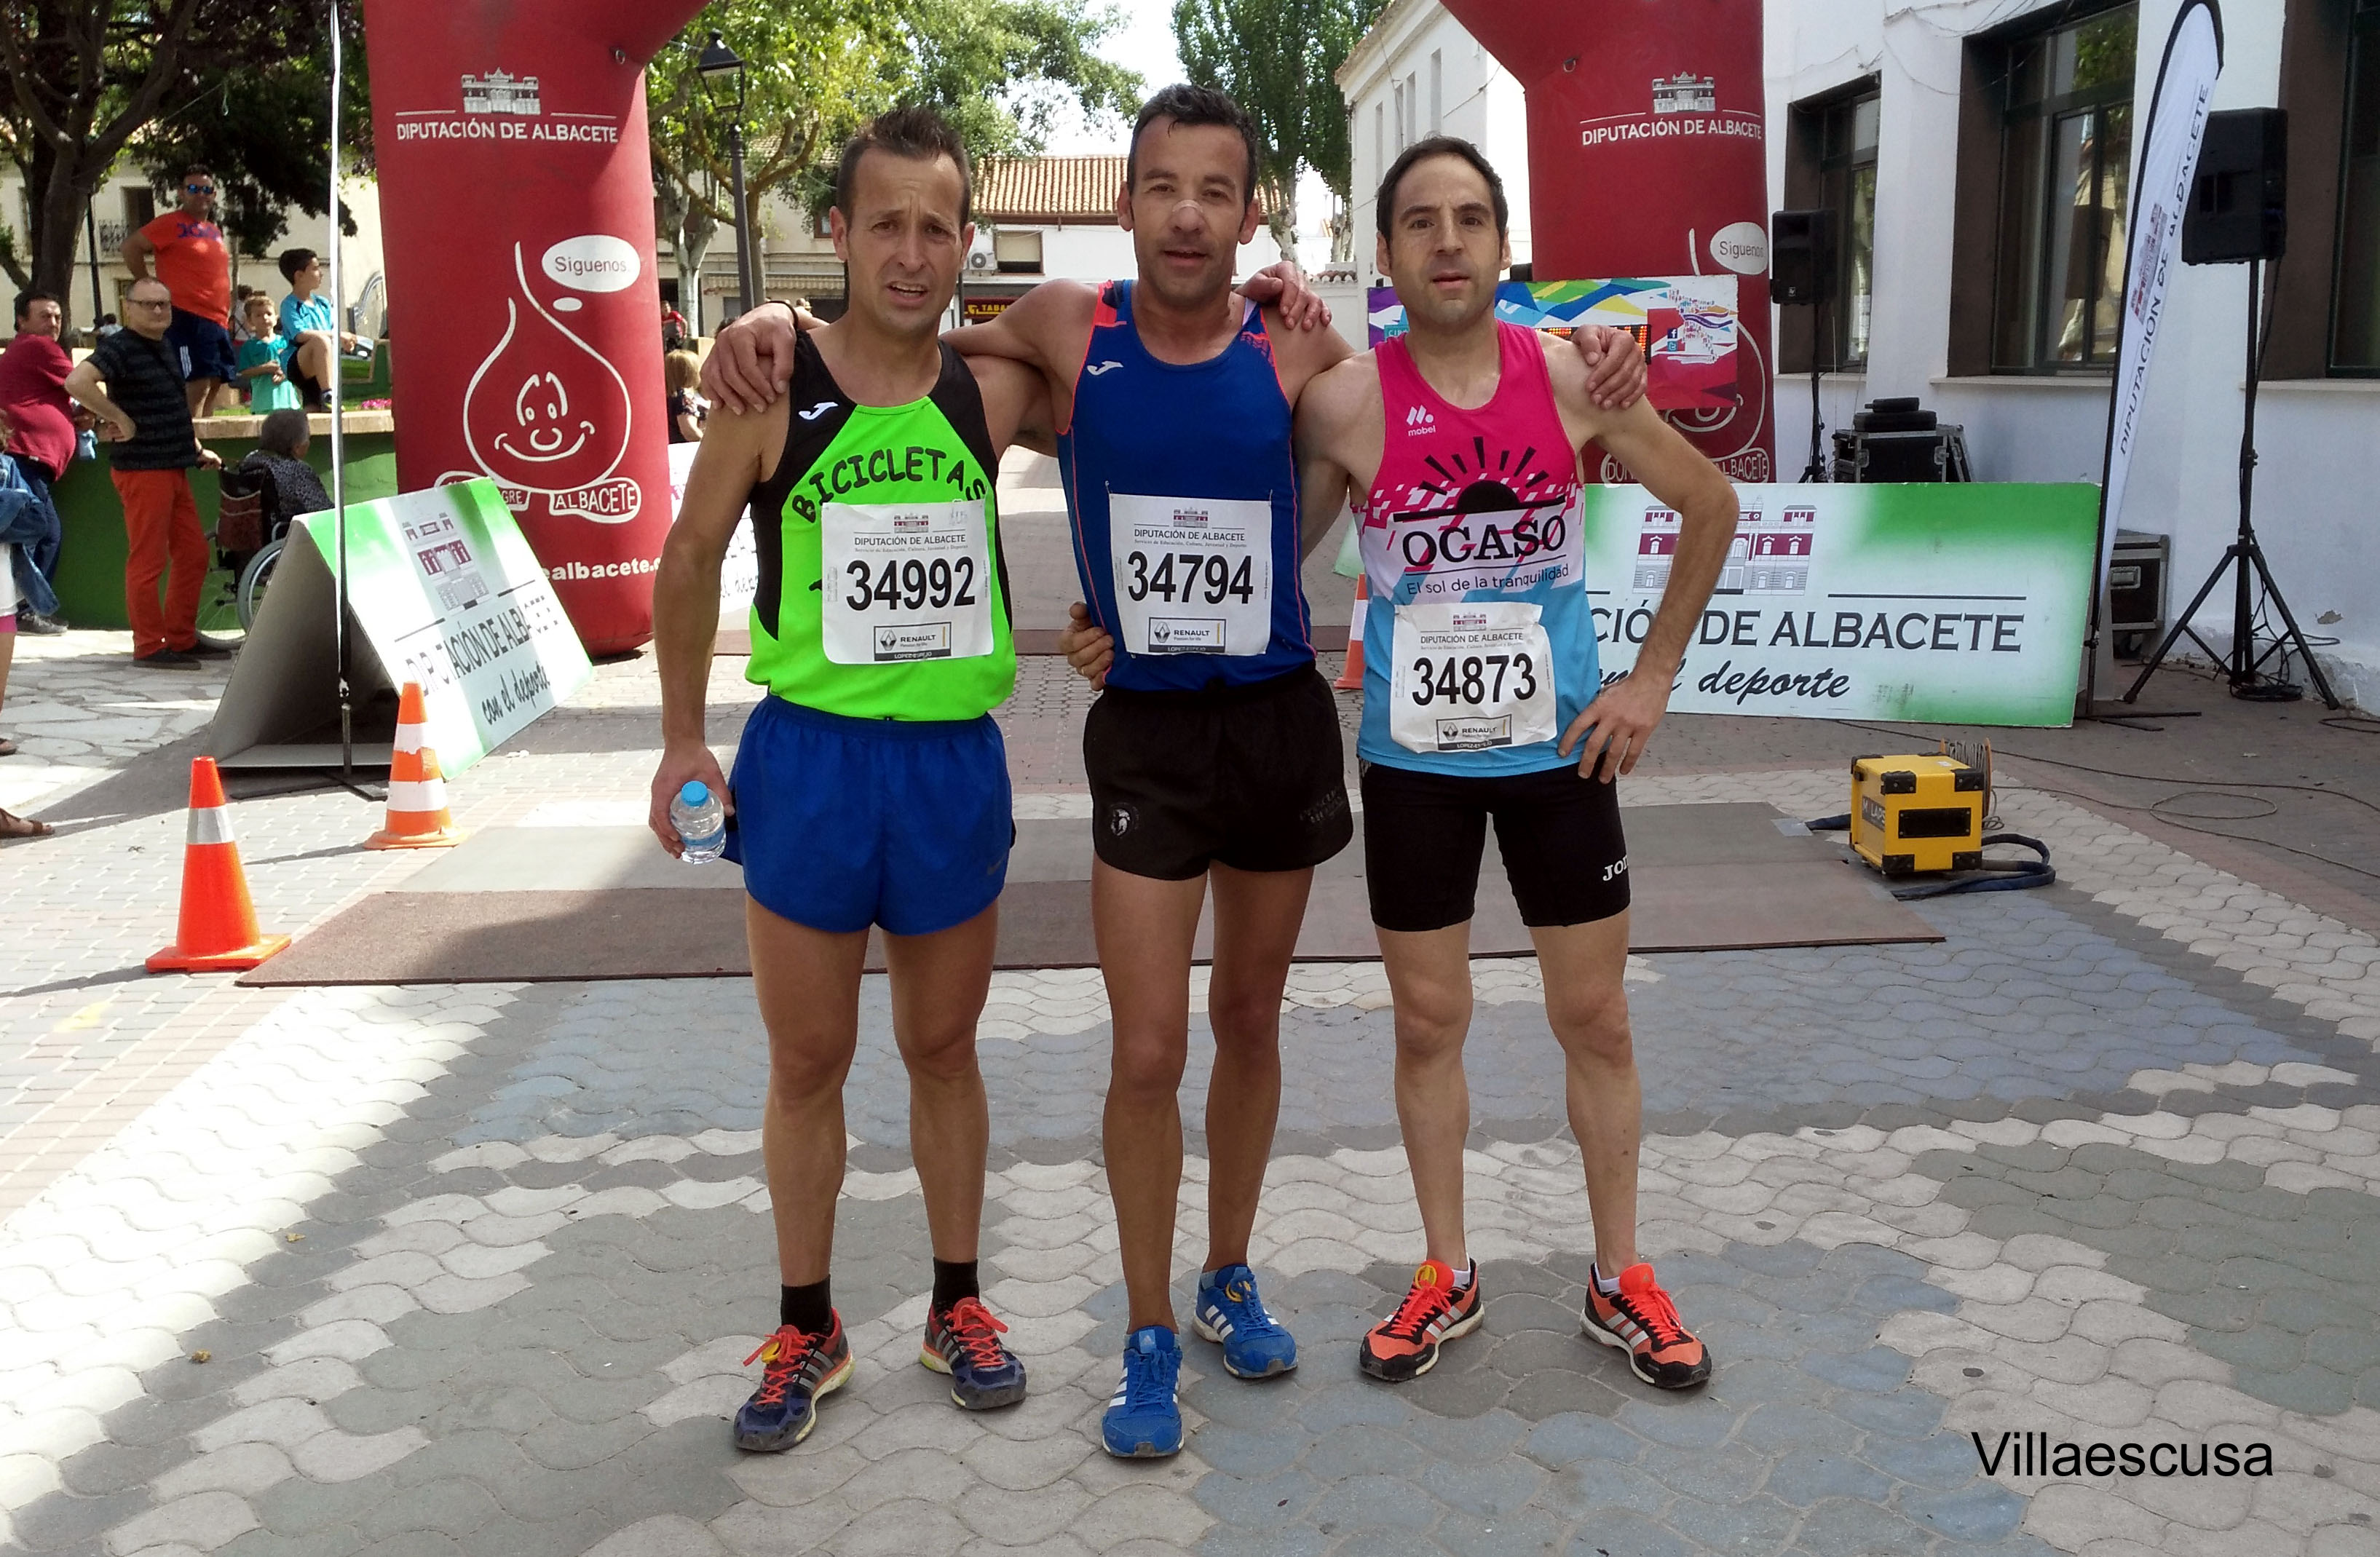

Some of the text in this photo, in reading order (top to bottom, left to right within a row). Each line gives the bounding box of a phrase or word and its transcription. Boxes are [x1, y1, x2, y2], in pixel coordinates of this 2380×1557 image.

[397, 117, 618, 143] DIPUTACIÓN DE ALBACETE
[1582, 118, 1762, 146] DIPUTACIÓN DE ALBACETE
[981, 304, 1011, 312] TABA
[1408, 425, 1436, 437] mobel
[555, 483, 637, 513] ALBACETE
[792, 446, 987, 523] BICICLETAS
[855, 536, 905, 546] DIPUTACIÓN
[924, 534, 966, 544] ALBACETE
[1134, 529, 1245, 542] DIPUTACIÓN DE ALBACETE
[1402, 515, 1565, 566] OCASO
[846, 555, 976, 611] 34992
[1128, 550, 1254, 605] 34794
[1407, 564, 1569, 595] El sol de la tranquilidad
[900, 635, 936, 643] RENAULT
[1420, 633, 1524, 644] DIPUTACIÓN DE ALBACETE
[1699, 609, 1762, 646] DE
[1768, 611, 2025, 653] ALBACETE
[1412, 652, 1537, 706] 34873
[1698, 660, 1851, 706] deporte
